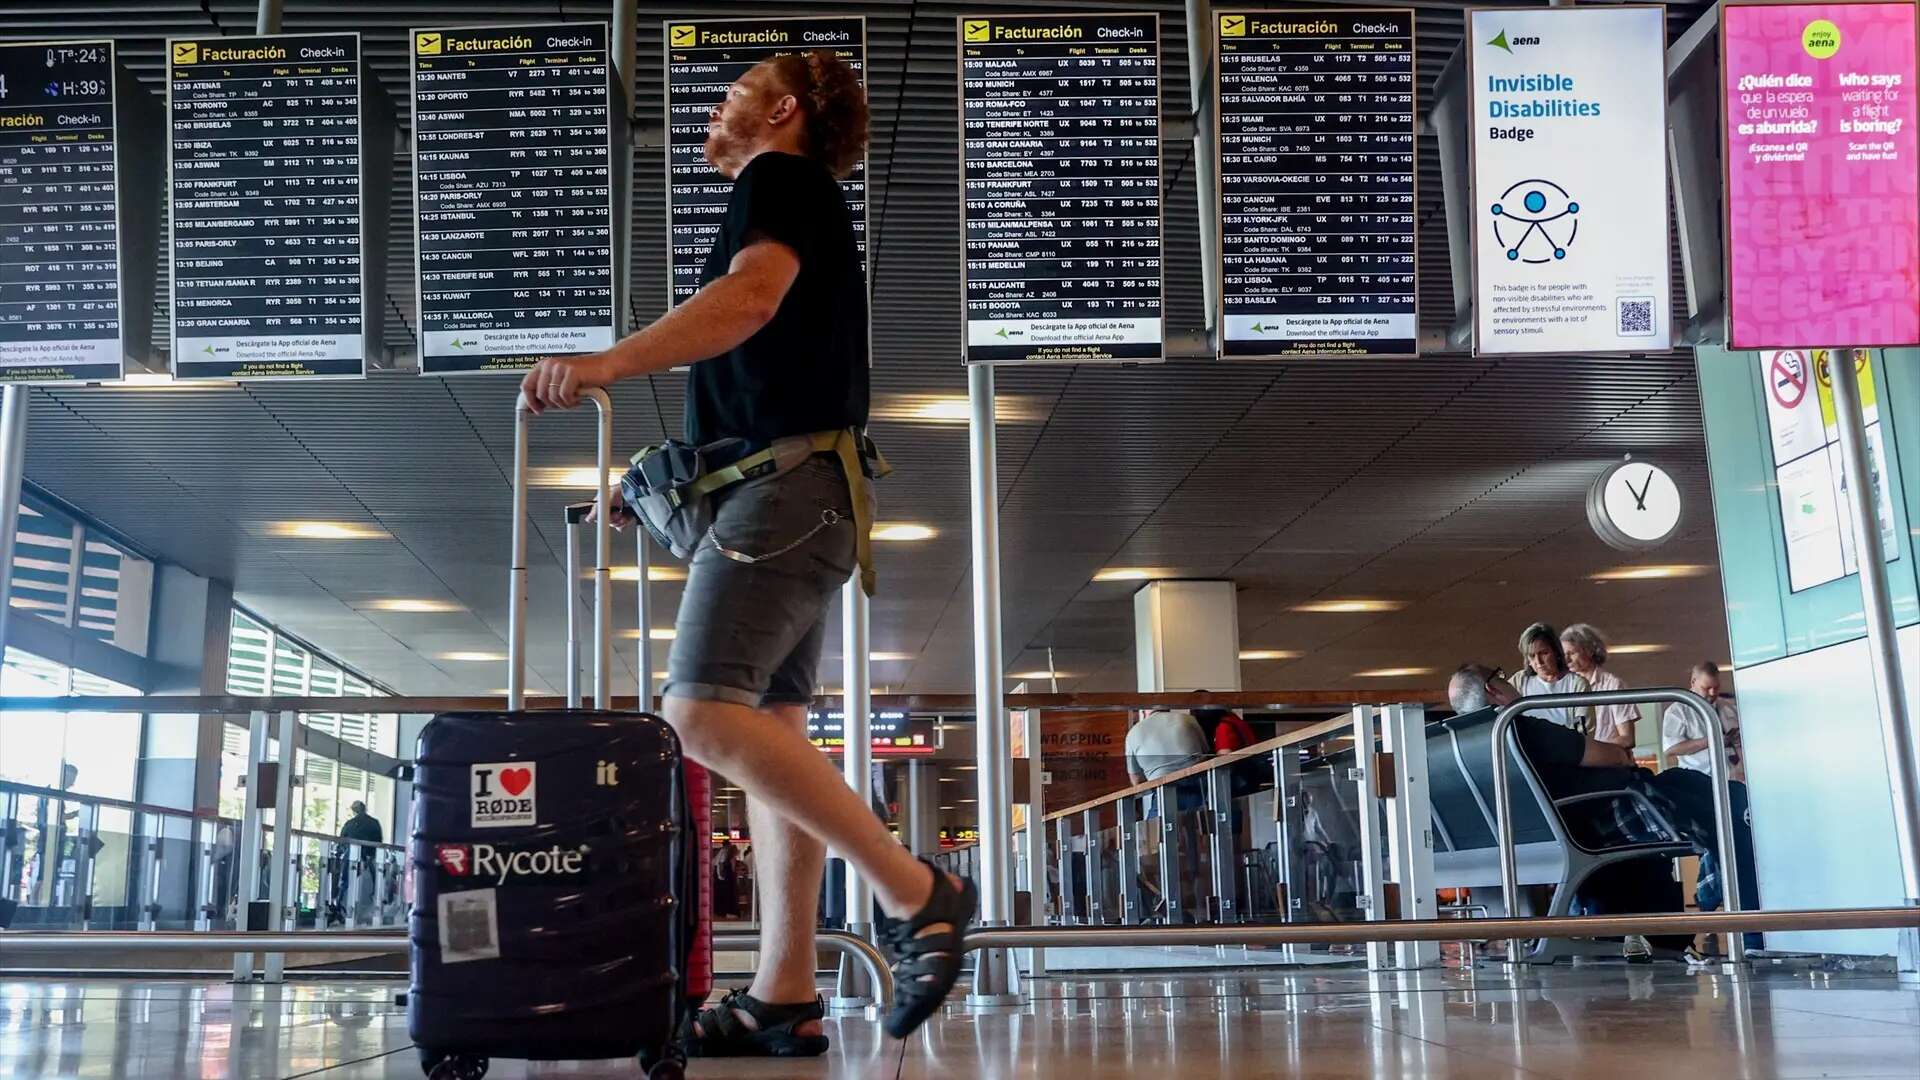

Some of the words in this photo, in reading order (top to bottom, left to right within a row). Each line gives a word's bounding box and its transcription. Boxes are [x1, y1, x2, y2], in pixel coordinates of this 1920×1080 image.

[995, 25, 1082, 39] Facturación
[1097, 28, 1143, 38] Check-in
[1251, 20, 1337, 34] Facturación
[1353, 23, 1398, 33] Check-in
[447, 36, 532, 51] Facturación
[547, 37, 592, 48] Check-in
[702, 30, 788, 44] Facturación
[803, 31, 849, 41] Check-in
[1512, 35, 1540, 45] aena
[1808, 39, 1834, 48] aena
[203, 46, 286, 61] Facturación
[301, 48, 344, 58] Check-in
[1488, 74, 1573, 92] Invisible
[1738, 73, 1783, 90] ¿Quién
[1786, 73, 1812, 87] dice
[1839, 73, 1869, 86] Who
[1871, 74, 1902, 90] says
[1741, 93, 1762, 107] que
[1766, 91, 1775, 102] la
[1777, 91, 1814, 105] espera
[1842, 90, 1882, 106] waiting
[1884, 89, 1899, 101] for
[1489, 100, 1600, 118] Disabilities
[1747, 106, 1761, 119] de
[1764, 107, 1778, 118] un
[1779, 106, 1808, 118] vuelo
[1853, 107, 1860, 117] a
[1862, 105, 1889, 119] flight
[0, 115, 43, 126] ración
[57, 114, 101, 124] Check-in
[1738, 123, 1754, 134] es
[1756, 120, 1817, 134] aburrida?
[1840, 119, 1851, 133] is
[1853, 119, 1902, 135] boring?
[1490, 127, 1534, 141] Badge
[1749, 144, 1785, 154] ¡Escanea
[1786, 143, 1794, 151] el
[1796, 142, 1808, 151] QR
[1849, 142, 1867, 151] Scan
[1868, 142, 1881, 150] the
[1883, 142, 1894, 150] QR
[1883, 152, 1897, 160] fun!
[1548, 284, 1570, 292] people
[1031, 323, 1065, 331] Descárgate
[596, 760, 619, 786] it
[475, 770, 491, 798] I
[476, 799, 532, 815] RØDE
[472, 844, 582, 886] Rycote
